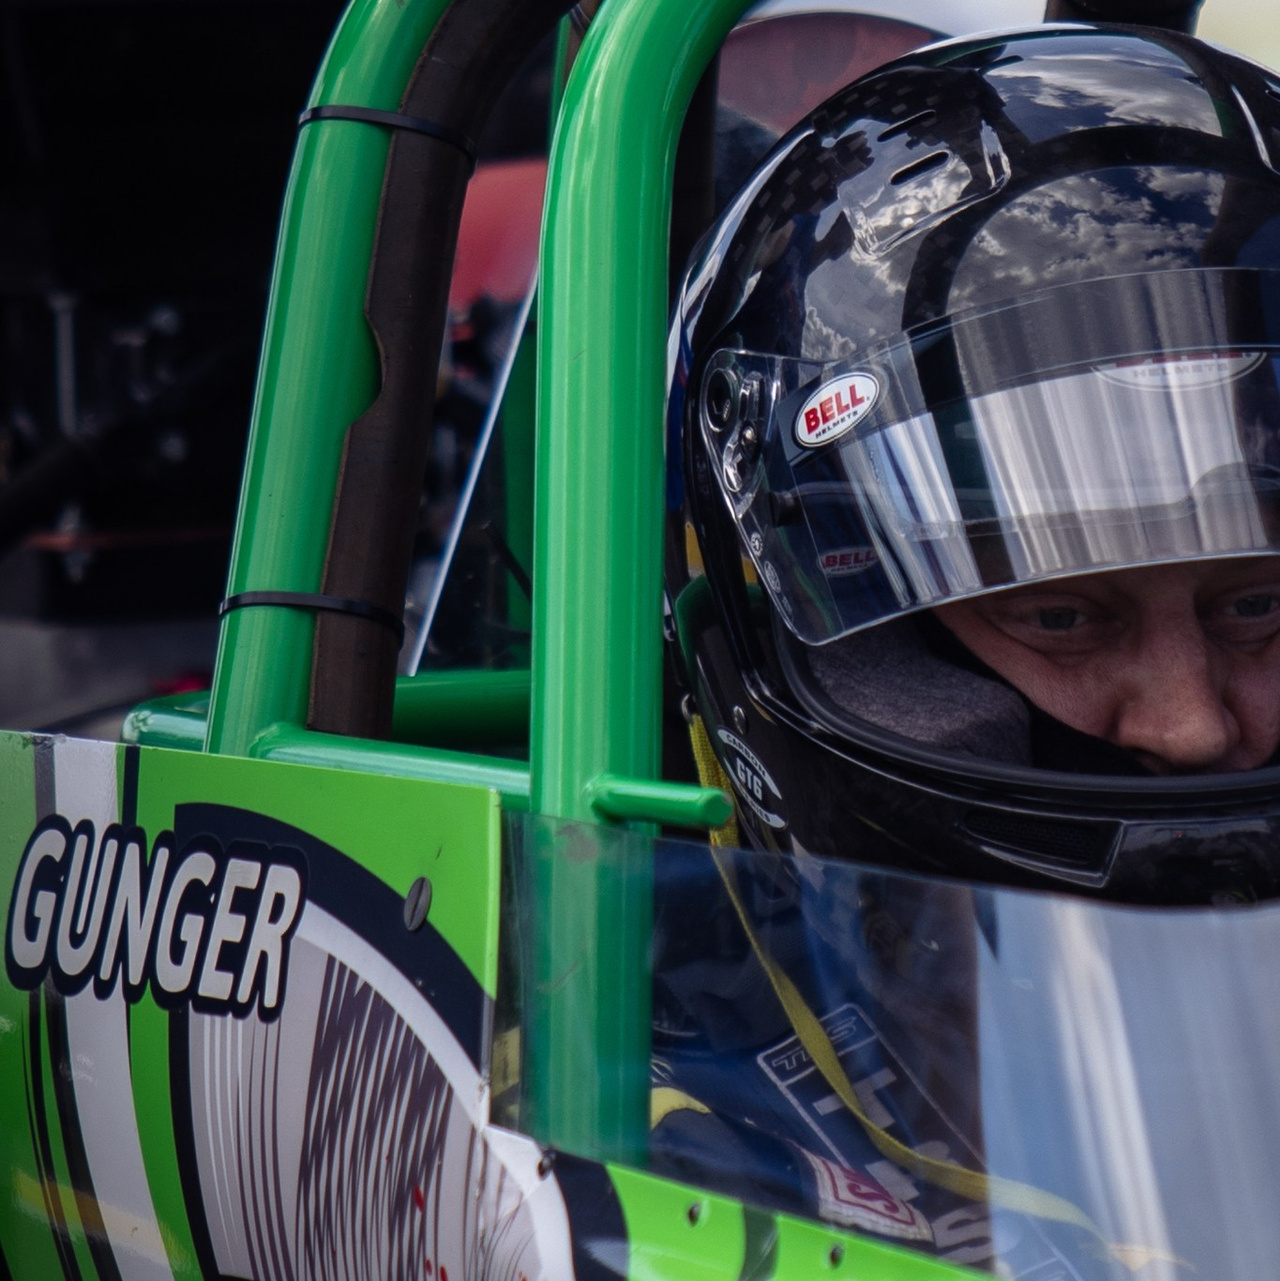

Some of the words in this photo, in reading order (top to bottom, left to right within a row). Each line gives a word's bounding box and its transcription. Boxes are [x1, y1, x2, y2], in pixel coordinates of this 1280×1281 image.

[804, 384, 866, 435] BELL
[815, 410, 859, 439] HELMETS
[9, 827, 303, 1010] GUNGER
